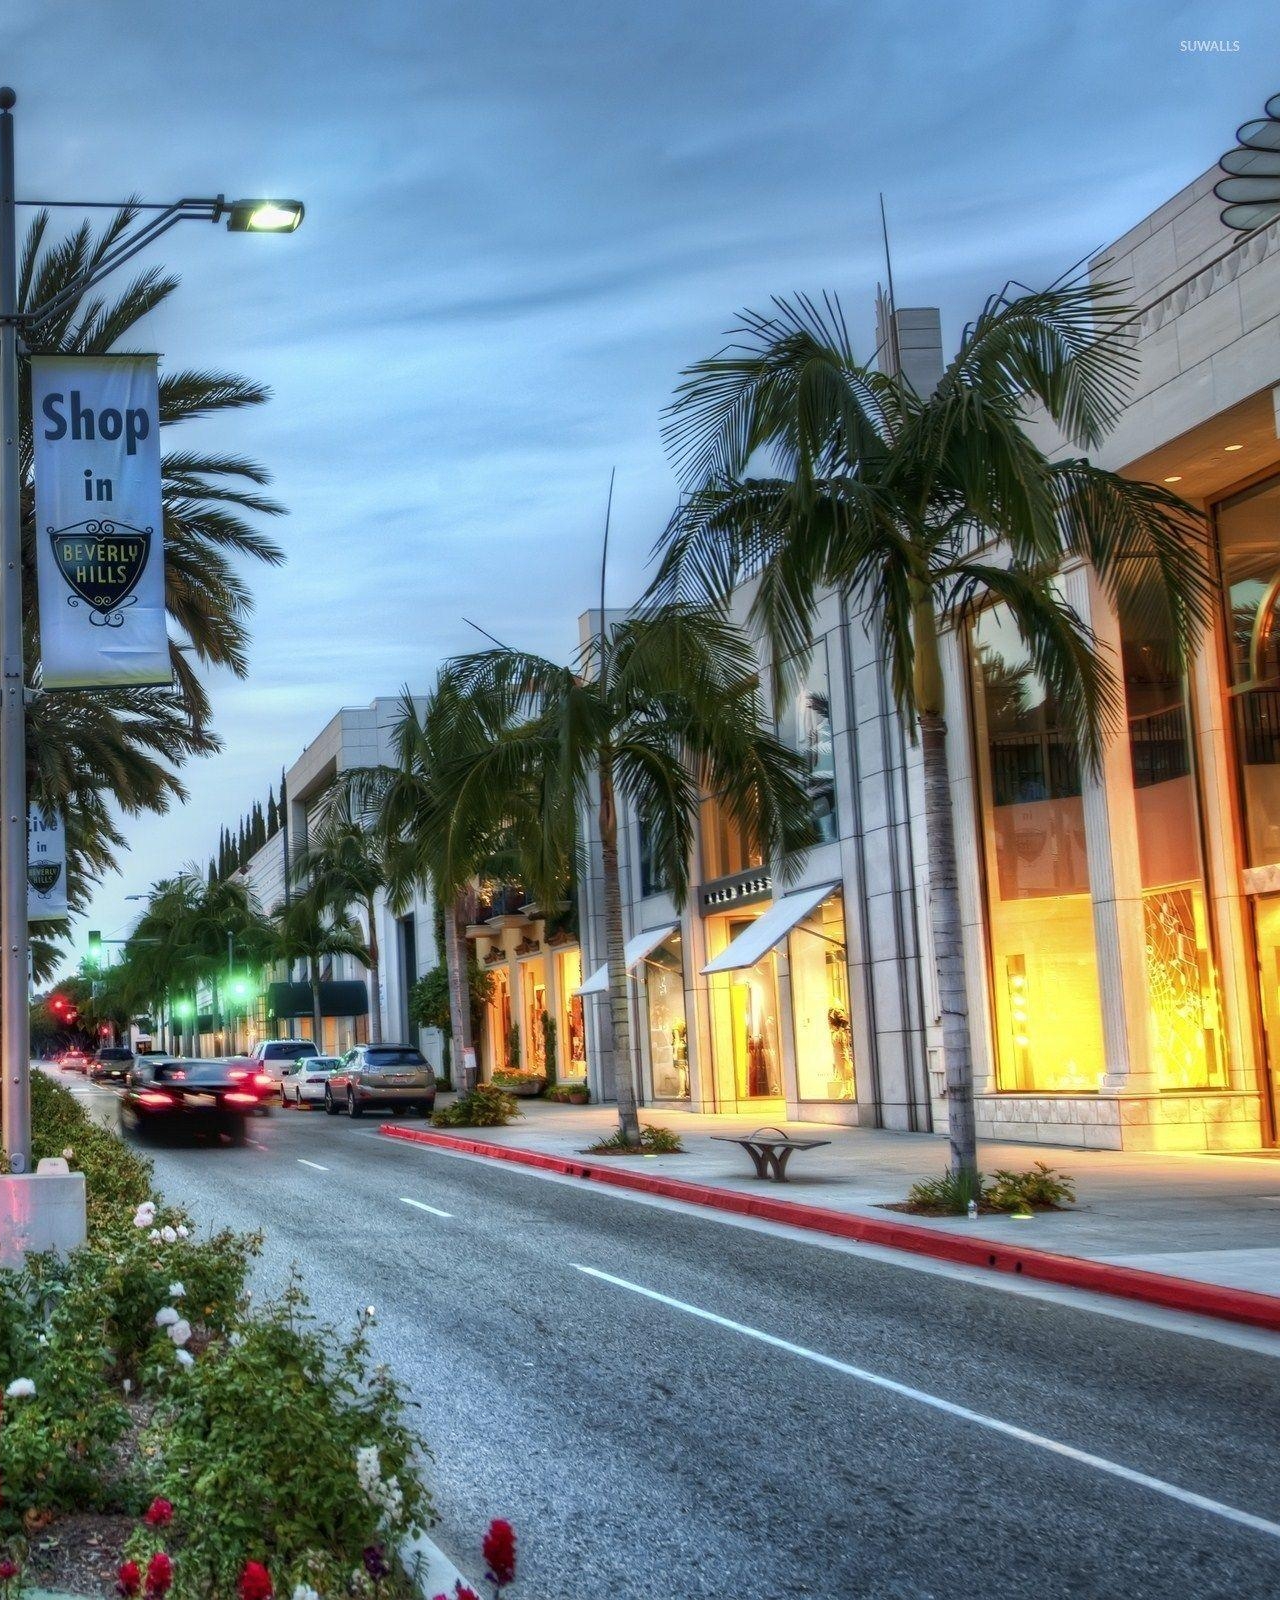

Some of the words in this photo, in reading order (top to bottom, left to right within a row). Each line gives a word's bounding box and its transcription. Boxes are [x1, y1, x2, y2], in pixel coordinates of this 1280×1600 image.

[42, 390, 150, 456] Shop
[83, 468, 113, 501] in
[63, 544, 138, 563] BEVERLY
[76, 565, 127, 584] HILLS
[36, 841, 47, 852] in
[33, 876, 54, 885] HILLS
